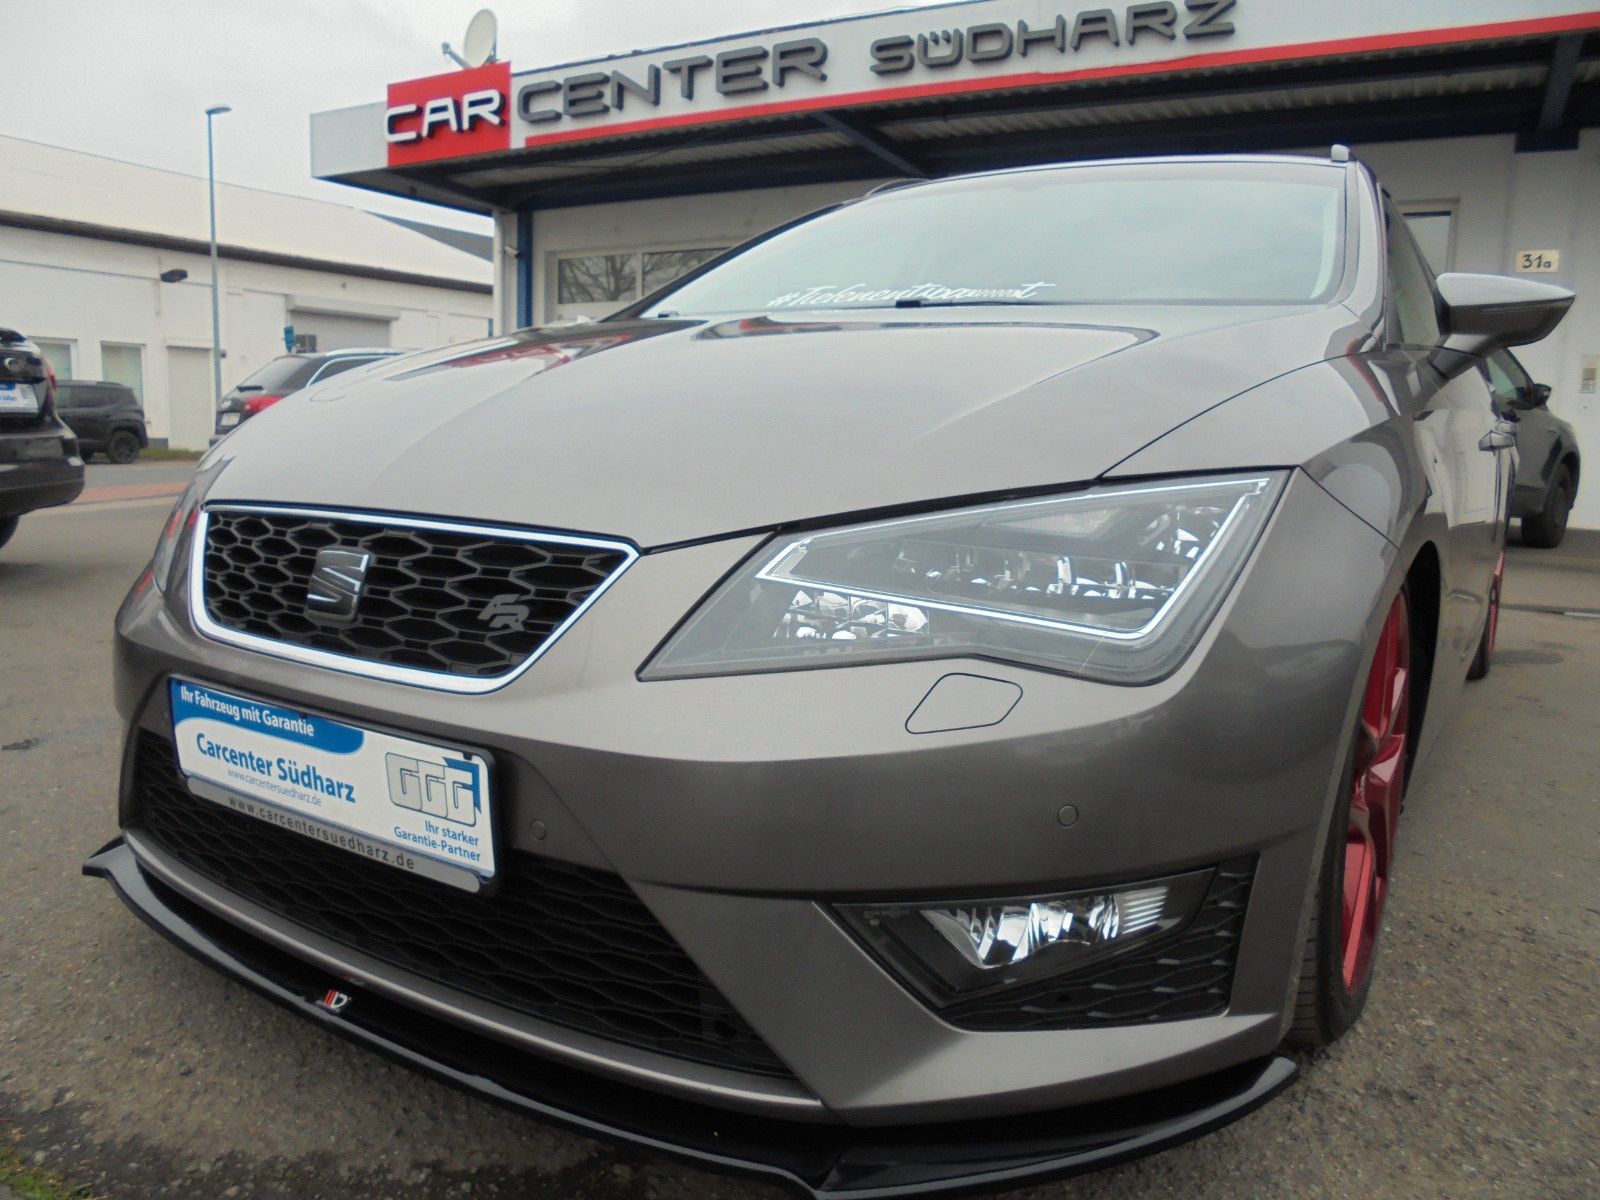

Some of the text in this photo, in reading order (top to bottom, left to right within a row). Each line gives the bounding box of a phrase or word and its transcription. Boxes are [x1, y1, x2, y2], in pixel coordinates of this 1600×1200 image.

[385, 0, 1236, 143] CAR CENTER SÜDHARZ
[1522, 253, 1552, 269] 31a
[180, 686, 315, 737] Ihr Fahrzeug mit Garantie
[196, 732, 357, 804] Carcenter Südharz
[227, 767, 322, 807] www.carcentersuedharz.de
[228, 797, 415, 870] www.carcentersuedharz.de
[394, 826, 481, 863] Garantie-Partner
[424, 820, 480, 847] Ihr starker
